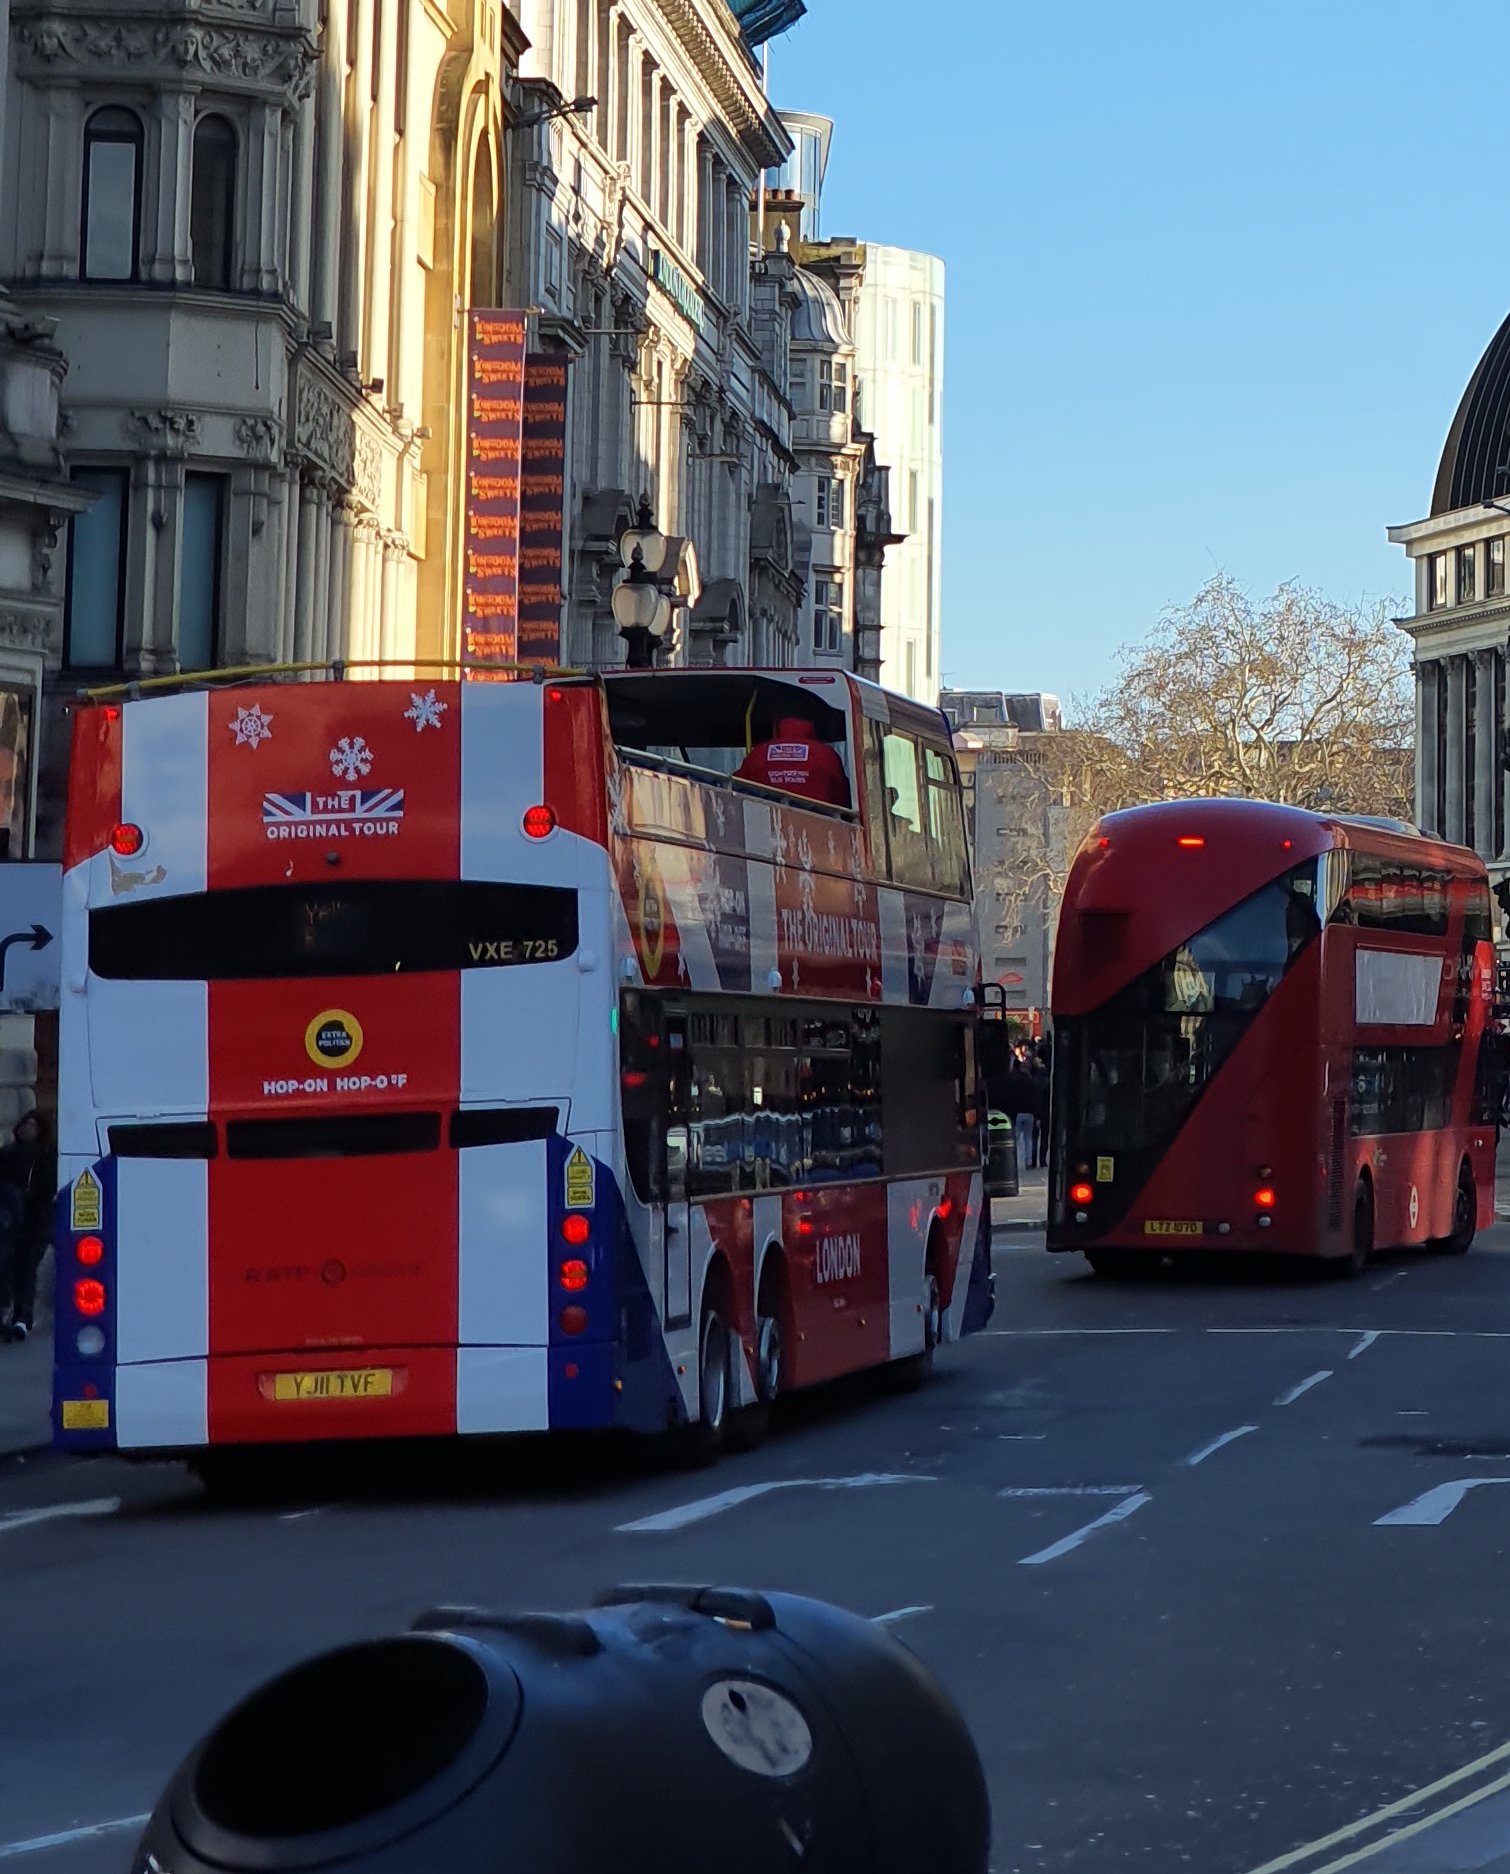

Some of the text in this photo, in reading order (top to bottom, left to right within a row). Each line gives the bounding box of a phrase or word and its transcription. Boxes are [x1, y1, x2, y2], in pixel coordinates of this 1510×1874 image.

[316, 796, 350, 810] THE
[266, 821, 399, 840] ORIGINAL TOUR
[781, 908, 803, 951] THE
[468, 939, 558, 962] VXE 725
[263, 1078, 328, 1095] HOP-ON
[816, 1233, 861, 1284] LONDON
[293, 1373, 376, 1396] YJ11 TVF
